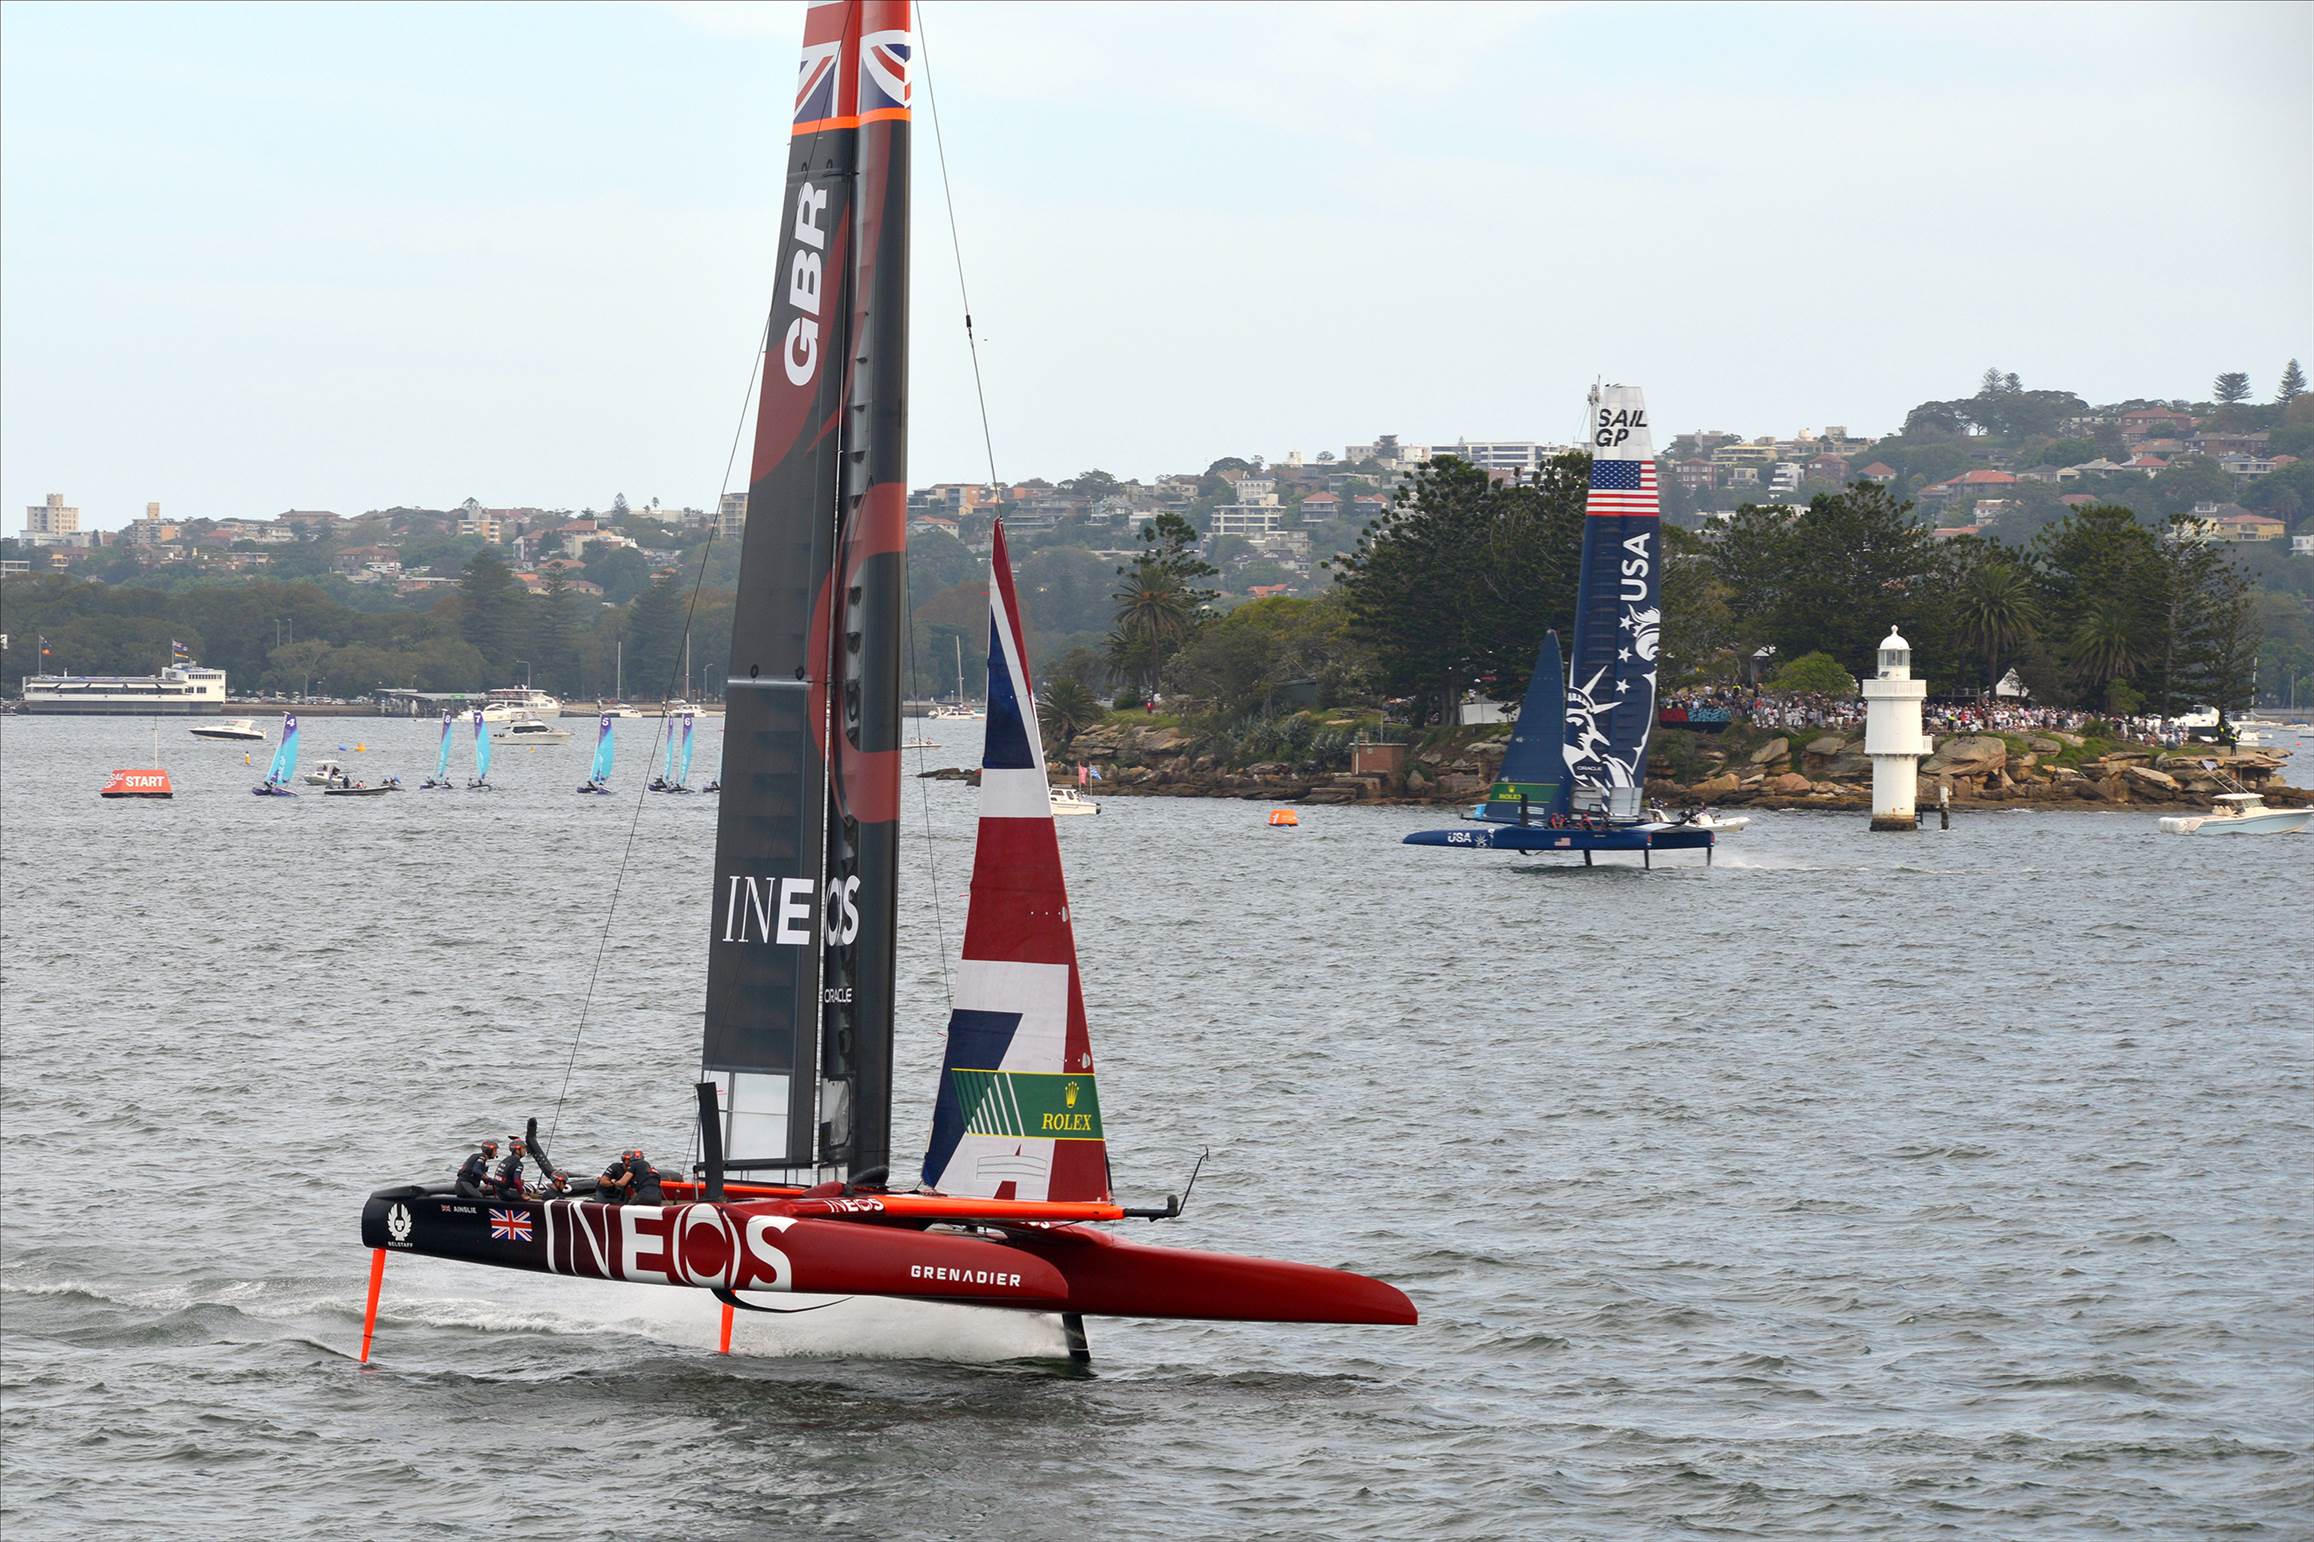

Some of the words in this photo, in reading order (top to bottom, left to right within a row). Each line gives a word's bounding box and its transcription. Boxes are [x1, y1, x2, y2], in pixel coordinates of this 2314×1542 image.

[784, 182, 827, 386] GBR
[1598, 409, 1648, 428] SAIL
[1595, 428, 1629, 447] GP
[1620, 532, 1650, 601] USA
[286, 718, 295, 727] 4
[475, 715, 481, 723] 7
[601, 717, 609, 726] 5
[684, 717, 691, 726] 6
[125, 775, 165, 787] START
[1447, 832, 1472, 843] USA
[722, 875, 861, 946] INEOS
[824, 988, 852, 1003] ORACLE
[1041, 1113, 1092, 1131] ROLEX
[453, 1206, 477, 1214] AINSLIE
[824, 1198, 884, 1213] INEOS
[544, 1200, 798, 1292] INEOS
[911, 1265, 1021, 1287] GRENADIER
